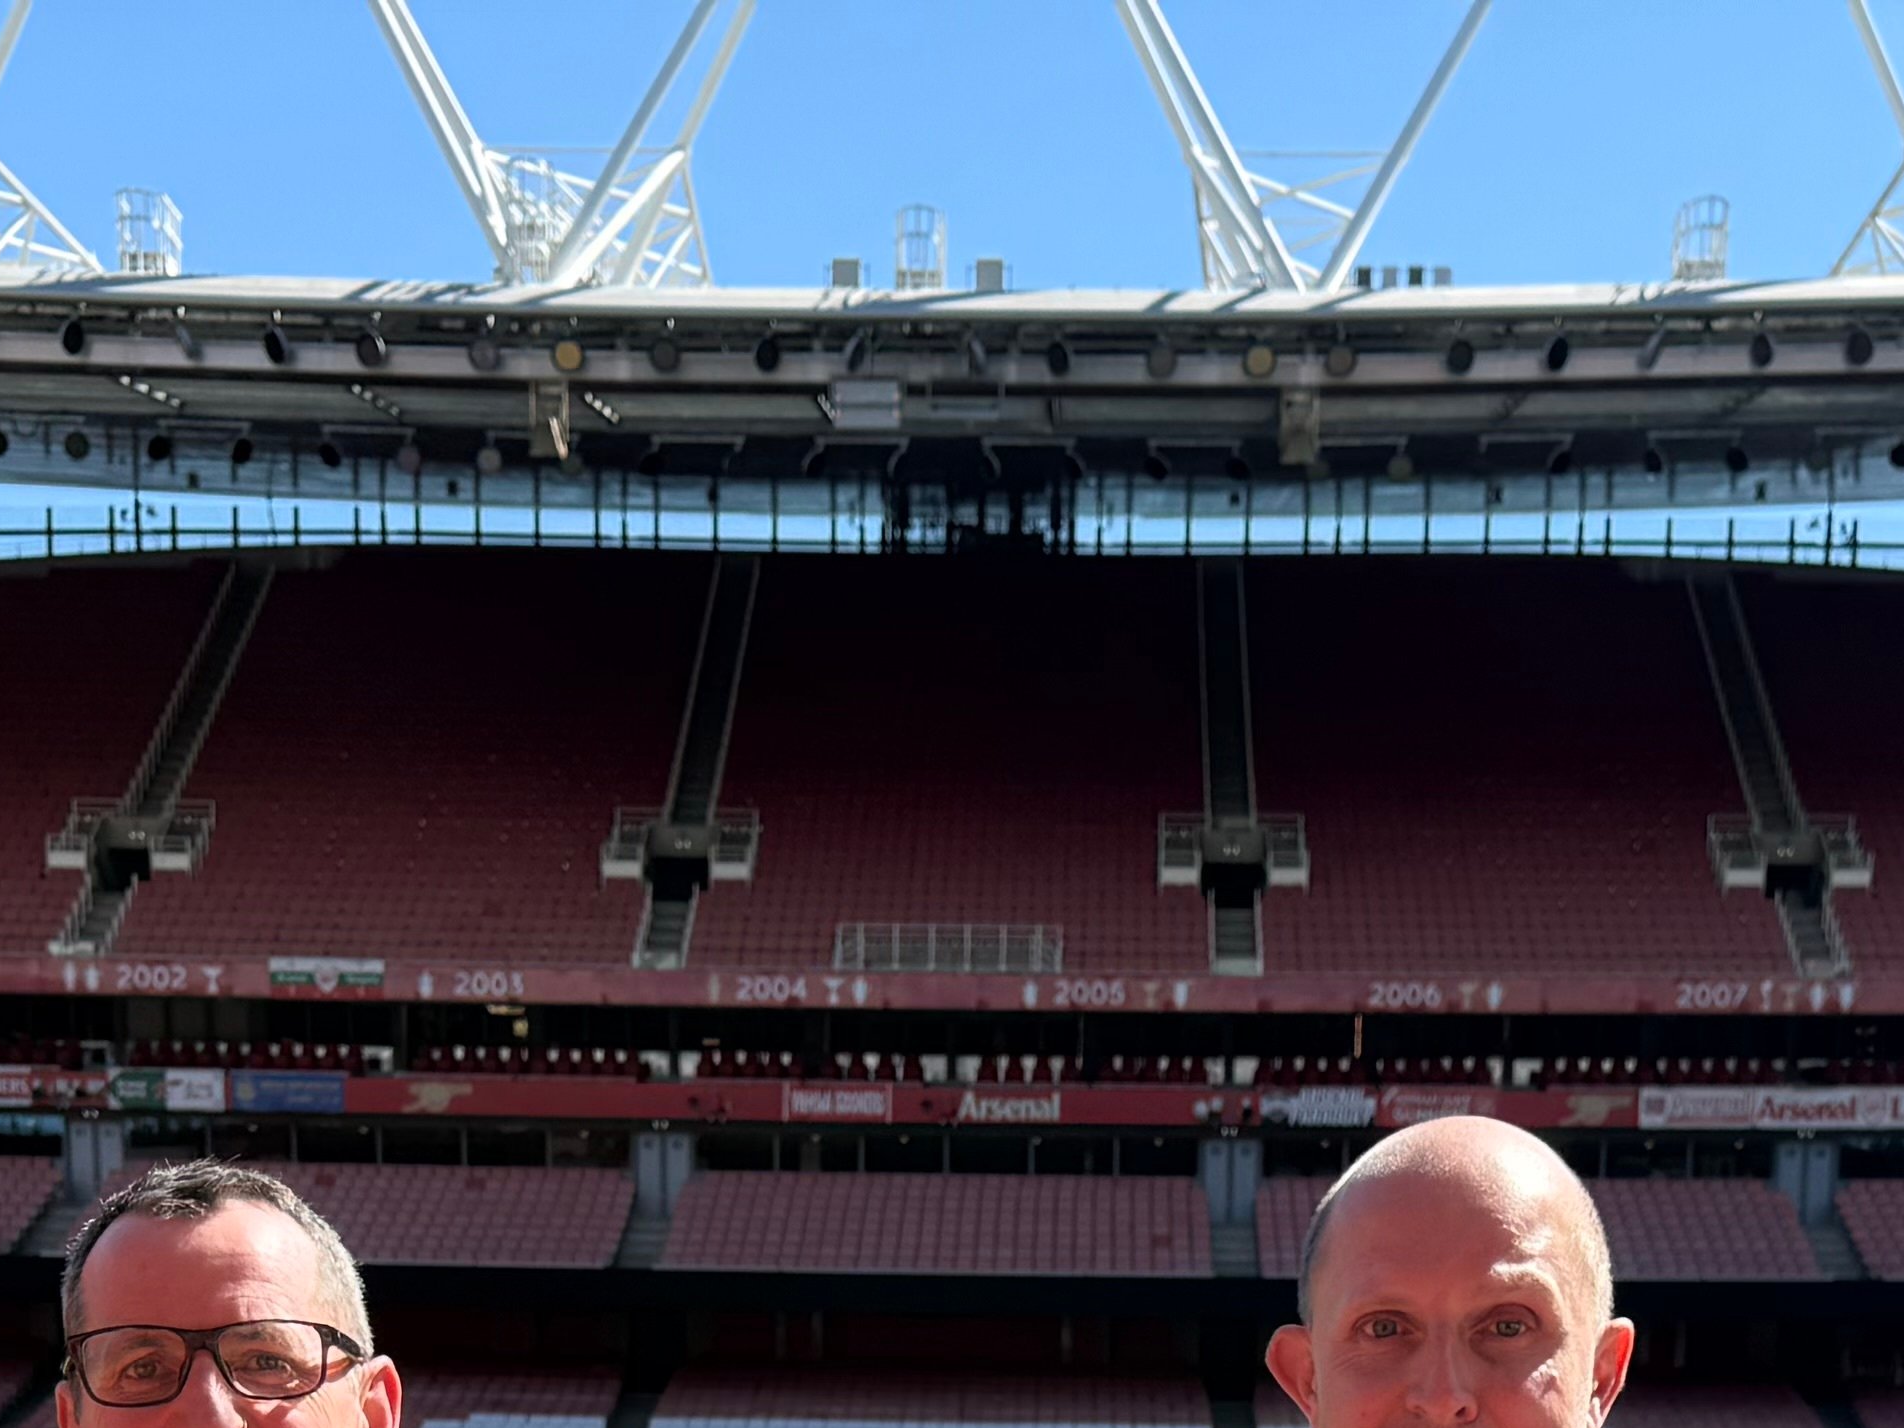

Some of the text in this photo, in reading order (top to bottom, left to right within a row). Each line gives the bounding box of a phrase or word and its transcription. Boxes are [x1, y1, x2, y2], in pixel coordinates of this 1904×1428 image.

[116, 964, 188, 988] 2002
[453, 971, 524, 996] 2003
[736, 977, 807, 1001] 2004
[1055, 980, 1126, 1006] 2005
[1368, 982, 1442, 1007] 2006
[1676, 983, 1749, 1008] 2007
[957, 1090, 1061, 1120] Arsenal
[1758, 1096, 1857, 1120] Arsenal
